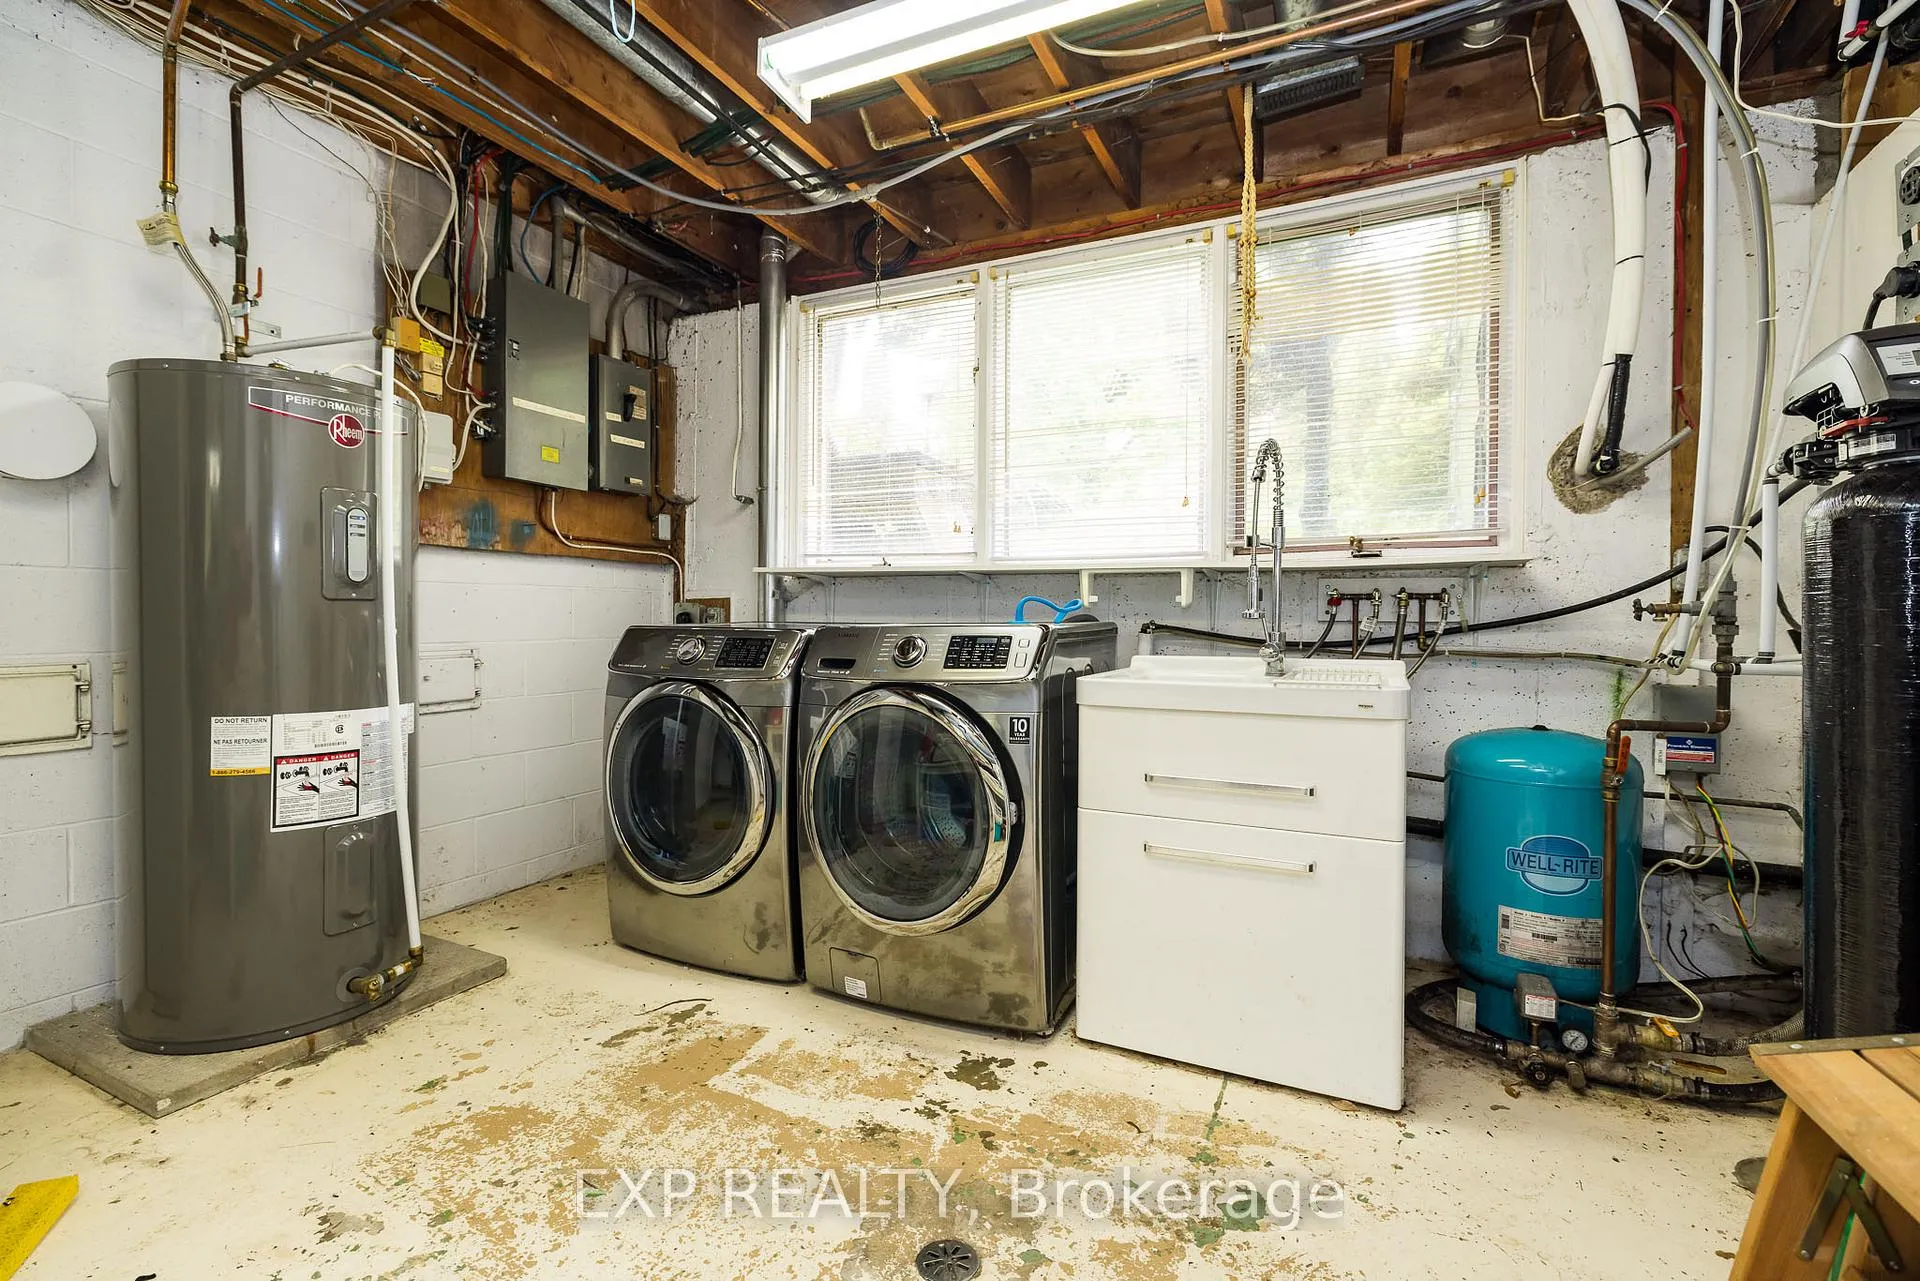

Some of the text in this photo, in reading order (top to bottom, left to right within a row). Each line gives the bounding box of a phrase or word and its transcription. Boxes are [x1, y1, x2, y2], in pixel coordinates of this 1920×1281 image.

[286, 394, 372, 417] PERFORMANCE
[333, 415, 363, 442] Rheem
[1012, 719, 1027, 732] 10
